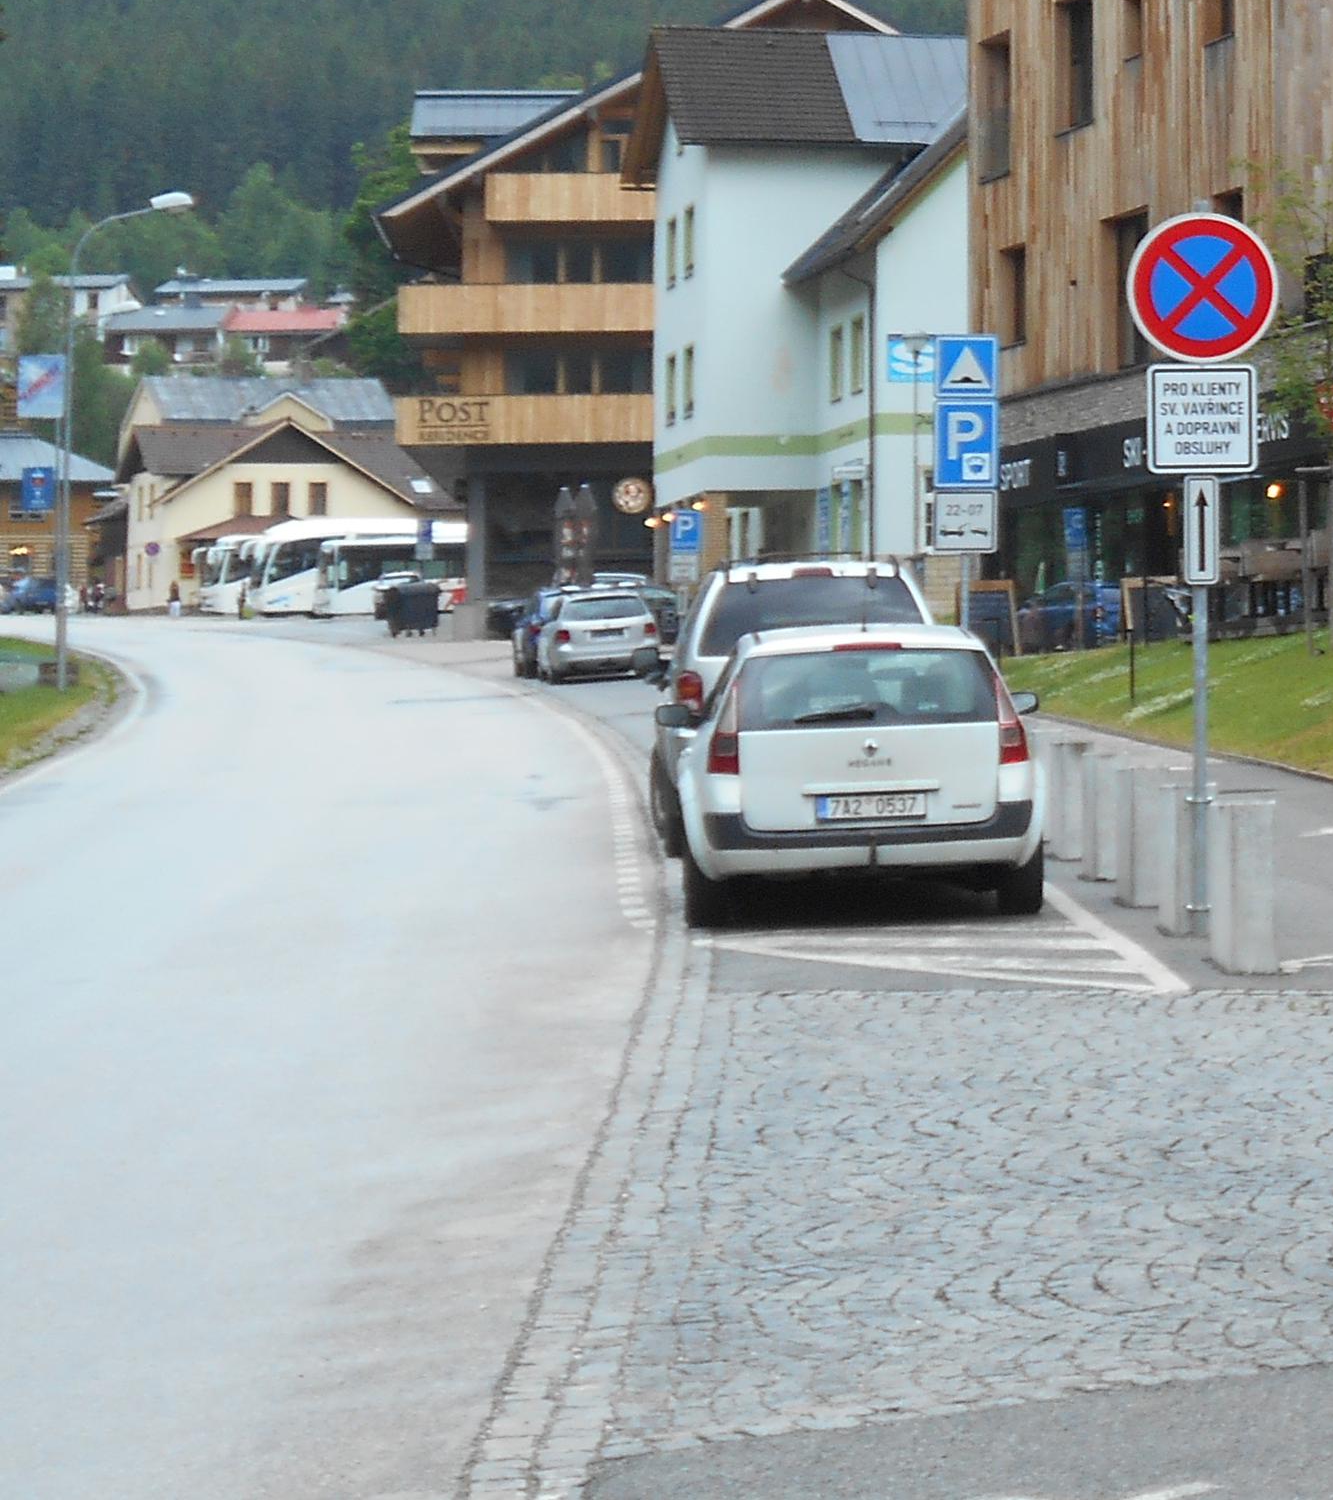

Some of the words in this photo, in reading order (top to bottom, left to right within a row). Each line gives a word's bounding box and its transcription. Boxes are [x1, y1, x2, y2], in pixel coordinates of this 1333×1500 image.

[1163, 382, 1188, 397] PRO
[1192, 381, 1242, 396] KLIENTY
[418, 399, 490, 423] POST
[1182, 397, 1245, 416] VAVŘINCE
[1165, 422, 1174, 436] A
[1177, 419, 1241, 436] DOPRAVNÍ
[1175, 440, 1231, 455] OBSLUHY
[875, 796, 918, 815] 0537
